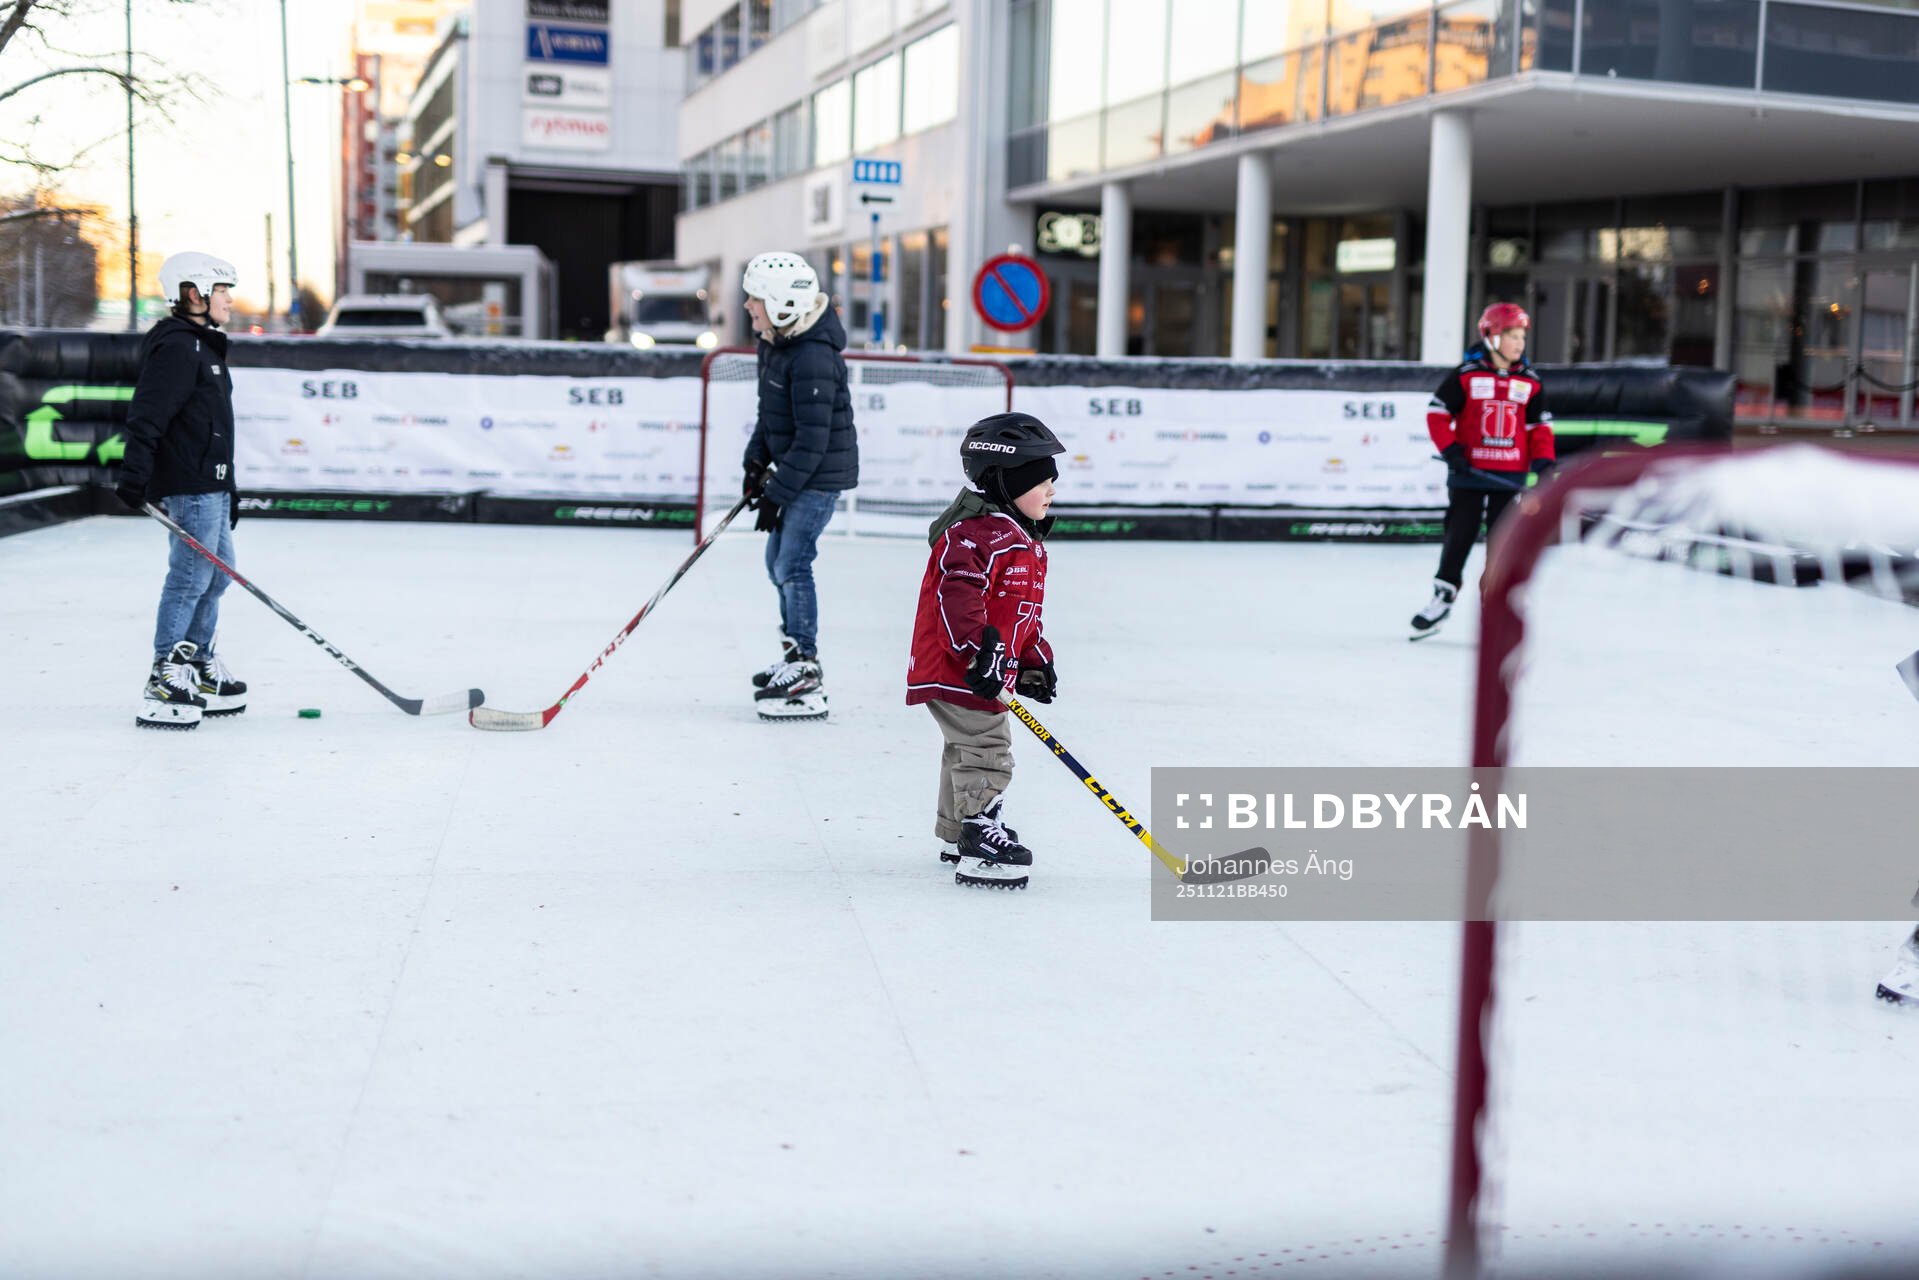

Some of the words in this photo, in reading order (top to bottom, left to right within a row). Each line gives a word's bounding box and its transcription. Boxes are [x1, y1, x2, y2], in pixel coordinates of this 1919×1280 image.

[302, 380, 358, 400] SEB
[569, 386, 624, 406] SEB
[1089, 398, 1143, 416] SEB
[1343, 401, 1397, 420] SEB
[968, 441, 1017, 454] occano
[215, 463, 227, 480] 19
[1007, 699, 1050, 742] KRONOR
[1084, 776, 1139, 828] CCM
